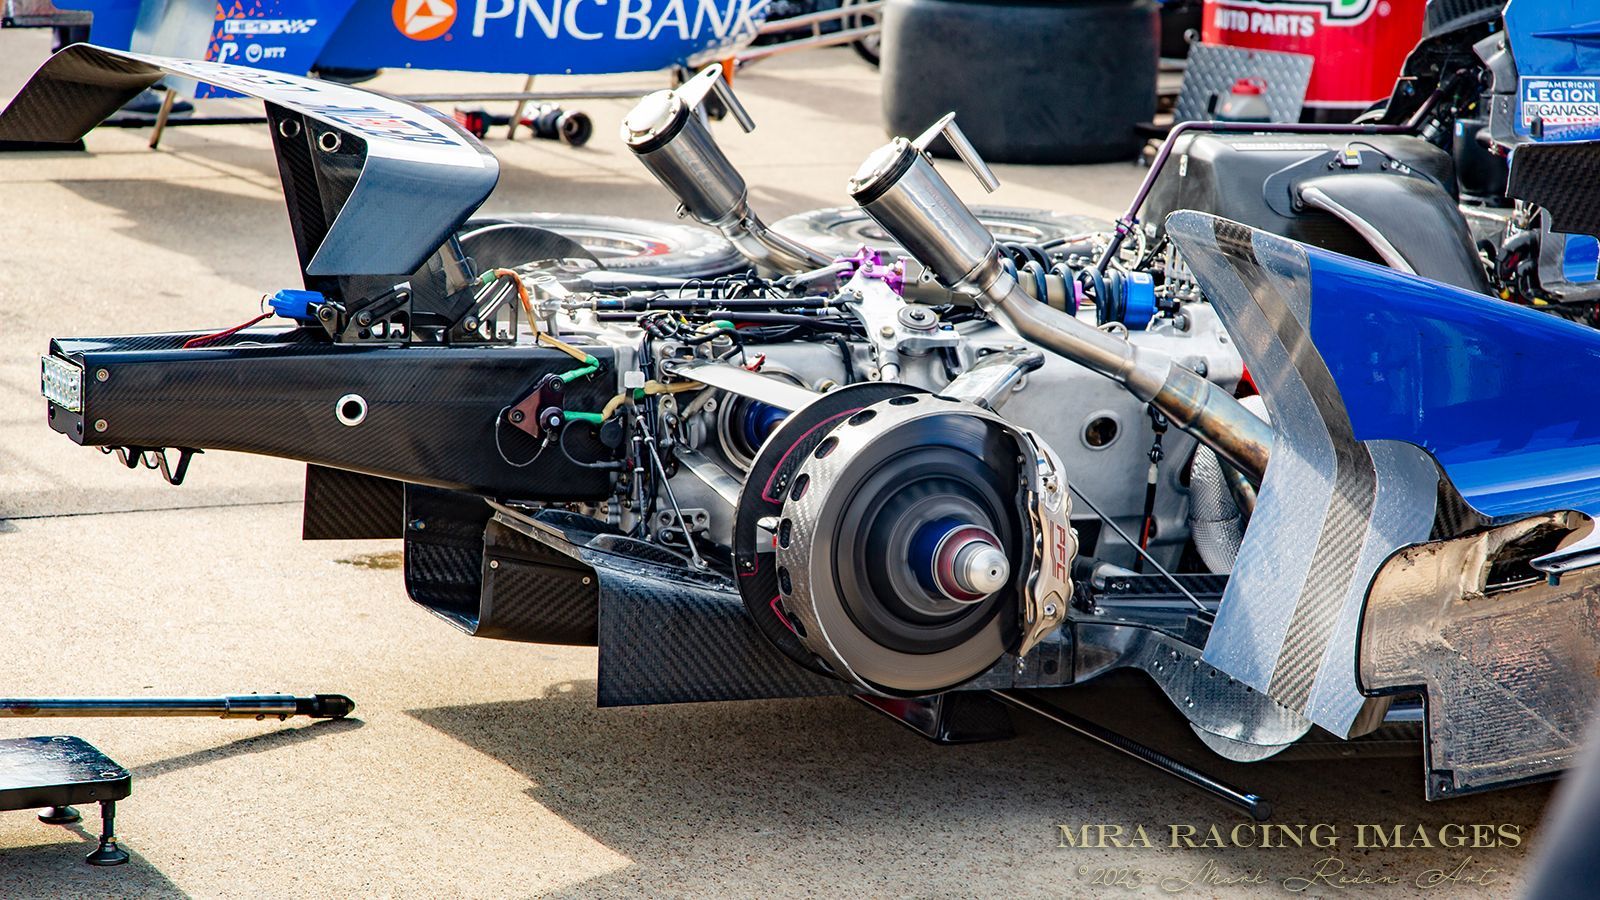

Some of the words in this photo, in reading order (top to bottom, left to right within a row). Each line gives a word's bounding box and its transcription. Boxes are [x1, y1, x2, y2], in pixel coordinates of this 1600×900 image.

[472, 0, 604, 40] PNC
[615, 0, 771, 41] BANK
[1213, 7, 1250, 33] AUTO
[1251, 12, 1316, 38] PARTS
[1527, 88, 1597, 102] LEGION
[1547, 81, 1596, 89] AMERICAN
[1540, 104, 1599, 117] GANASSI
[1056, 524, 1066, 584] PFC
